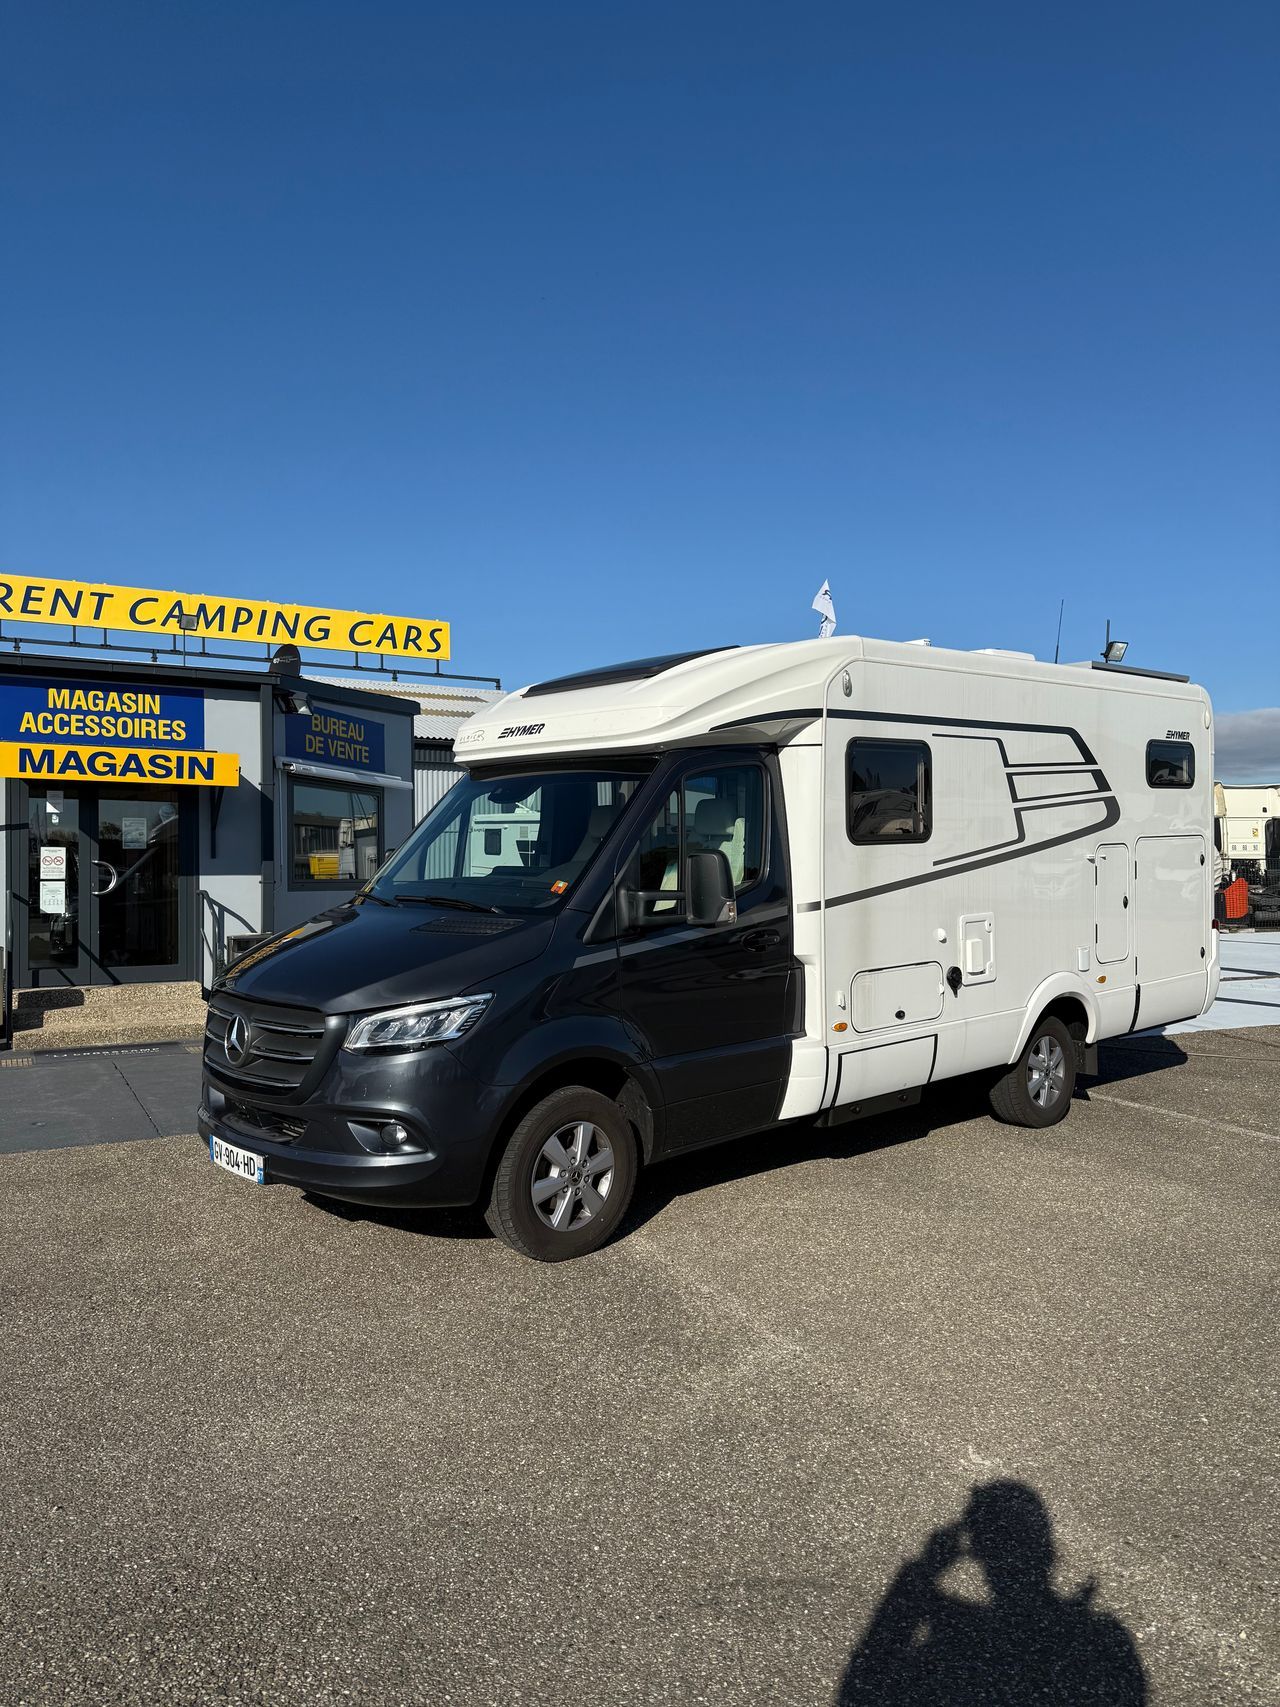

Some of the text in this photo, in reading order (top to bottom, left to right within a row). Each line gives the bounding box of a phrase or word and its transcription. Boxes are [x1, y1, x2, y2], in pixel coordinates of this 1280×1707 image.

[129, 597, 331, 642] CAMPING
[348, 620, 443, 653] CARS
[47, 688, 161, 715] MAGASIN
[19, 711, 187, 741] ACCESSOIRES
[311, 713, 365, 742] BUREAU
[18, 748, 215, 780] MAGASIN
[305, 734, 370, 764] DE VENTE
